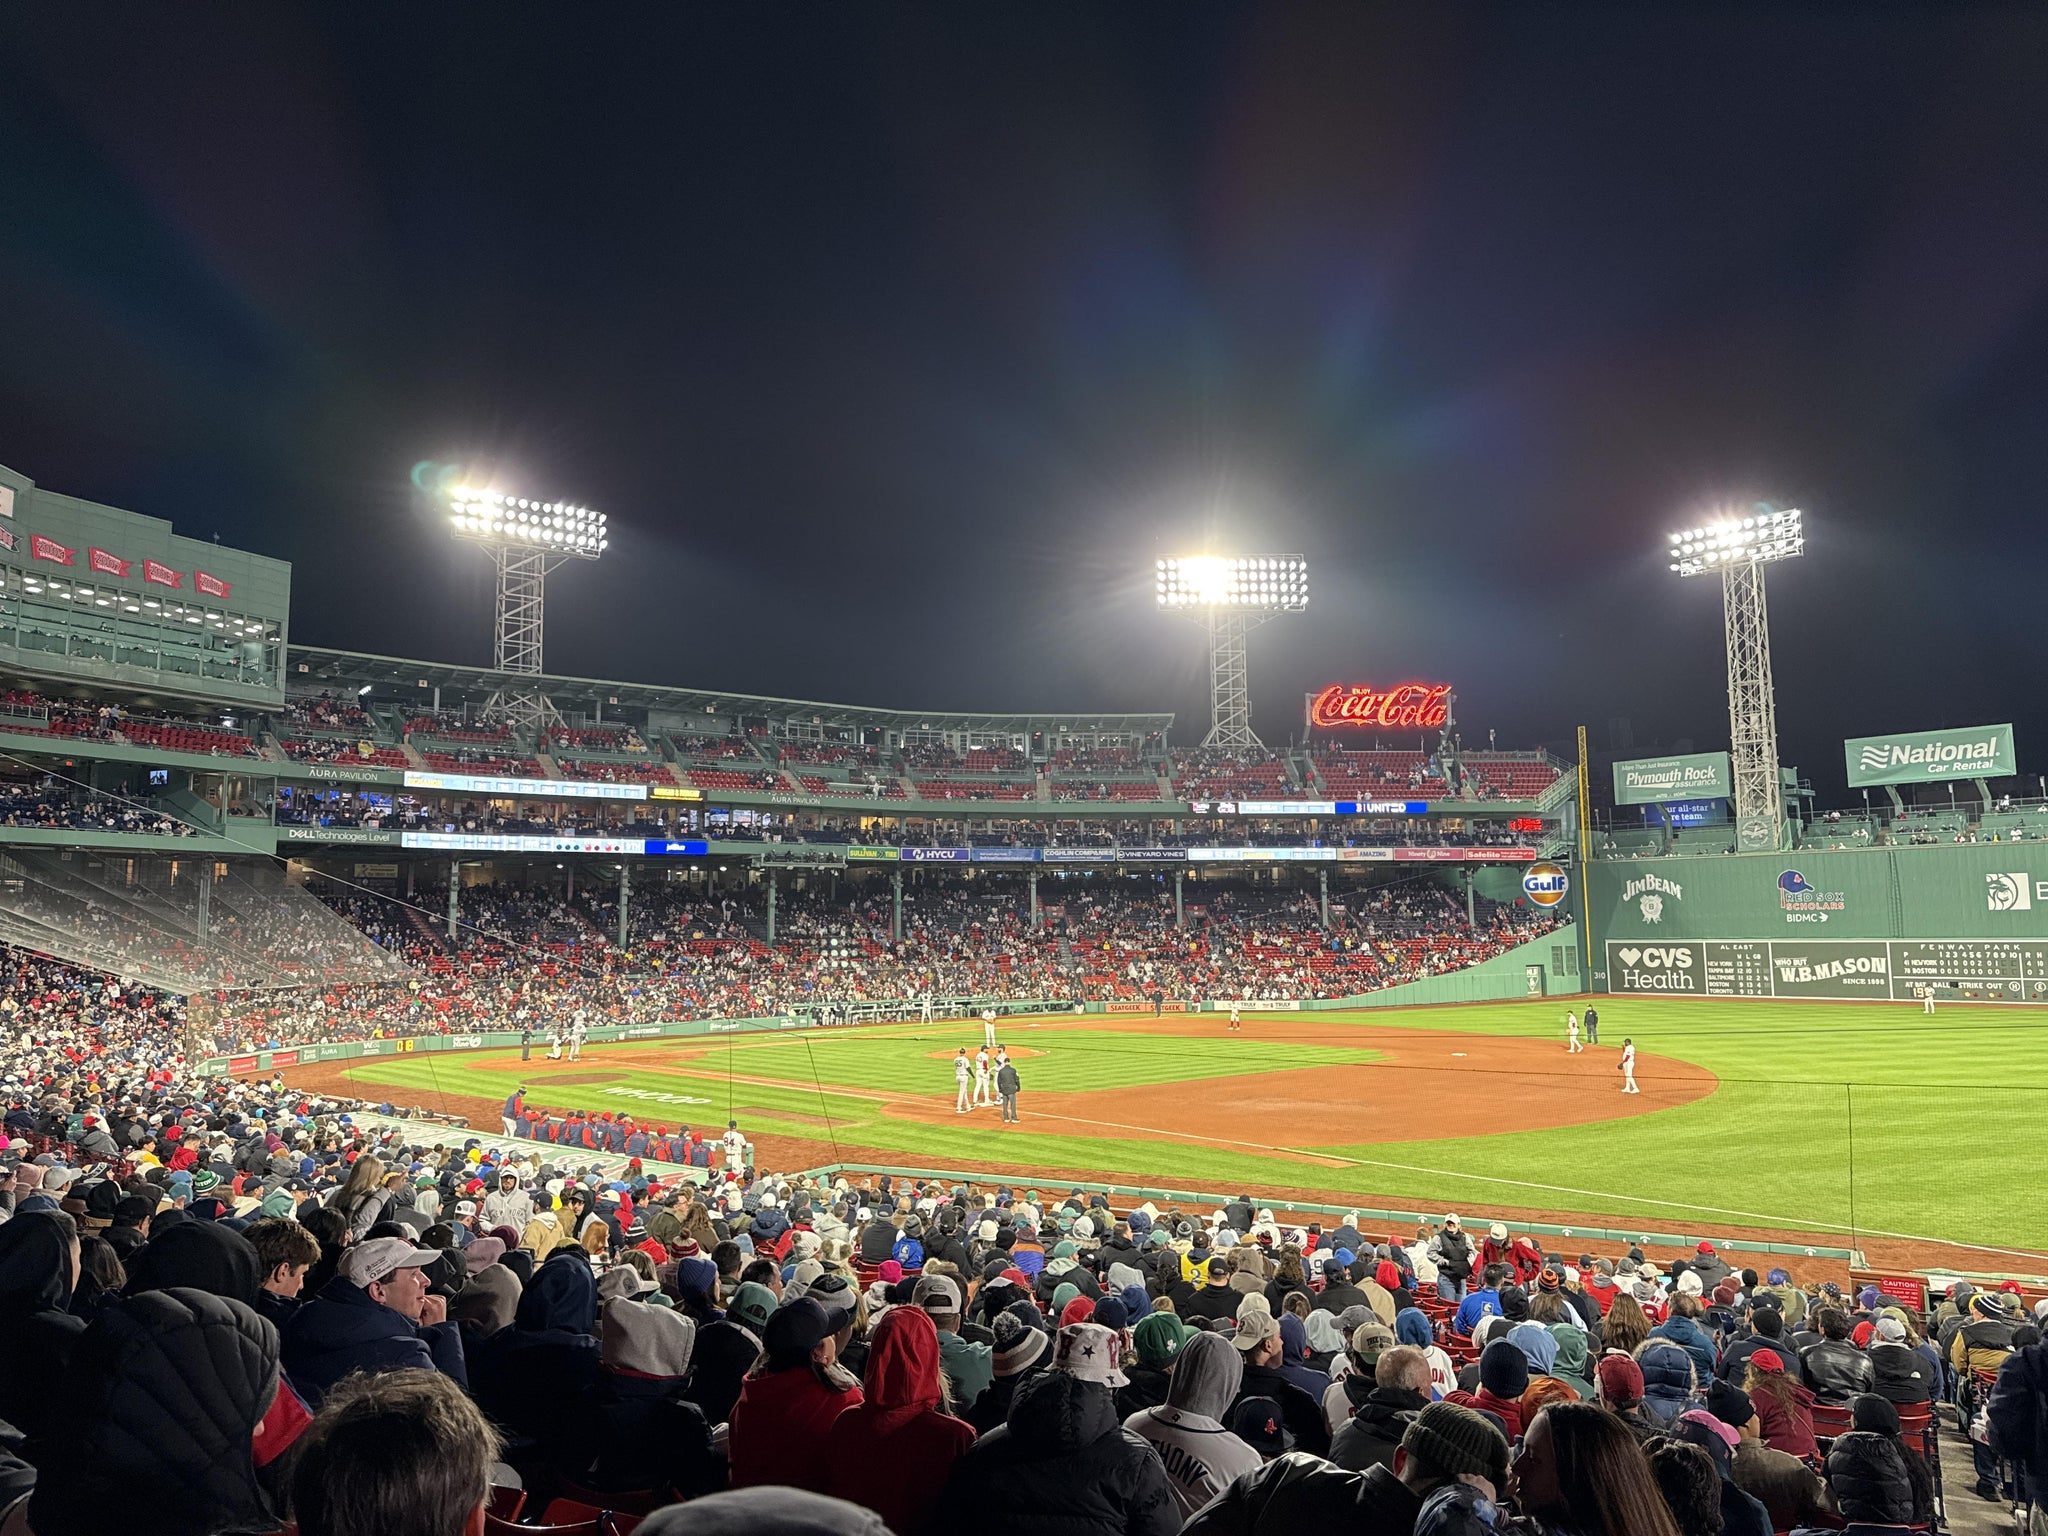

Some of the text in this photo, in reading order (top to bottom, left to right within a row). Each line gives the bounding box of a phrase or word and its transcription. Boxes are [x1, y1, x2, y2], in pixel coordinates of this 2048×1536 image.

[1312, 686, 1452, 726] Coca-Cola
[1928, 759, 1992, 772] Car Rental
[340, 771, 377, 781] PAVILION
[1626, 766, 1716, 786] Plymouth Rock
[1367, 803, 1406, 812] UNITED
[1681, 812, 1705, 820] team.
[289, 830, 389, 842] DELL Technologies Level
[926, 850, 955, 859] HYCU
[1525, 877, 1565, 890] Gulf
[1622, 874, 1683, 901] JIM BEAM
[1786, 892, 1844, 902] RED SOX
[1786, 902, 1844, 910] SCHOLARS
[1786, 914, 1817, 922] BIDMC
[1643, 948, 1692, 968] CVS
[1594, 972, 1605, 980] 310
[1622, 969, 1695, 989] Health
[1190, 1269, 1202, 1284] 2
[1883, 1280, 1918, 1288] CAUTION!
